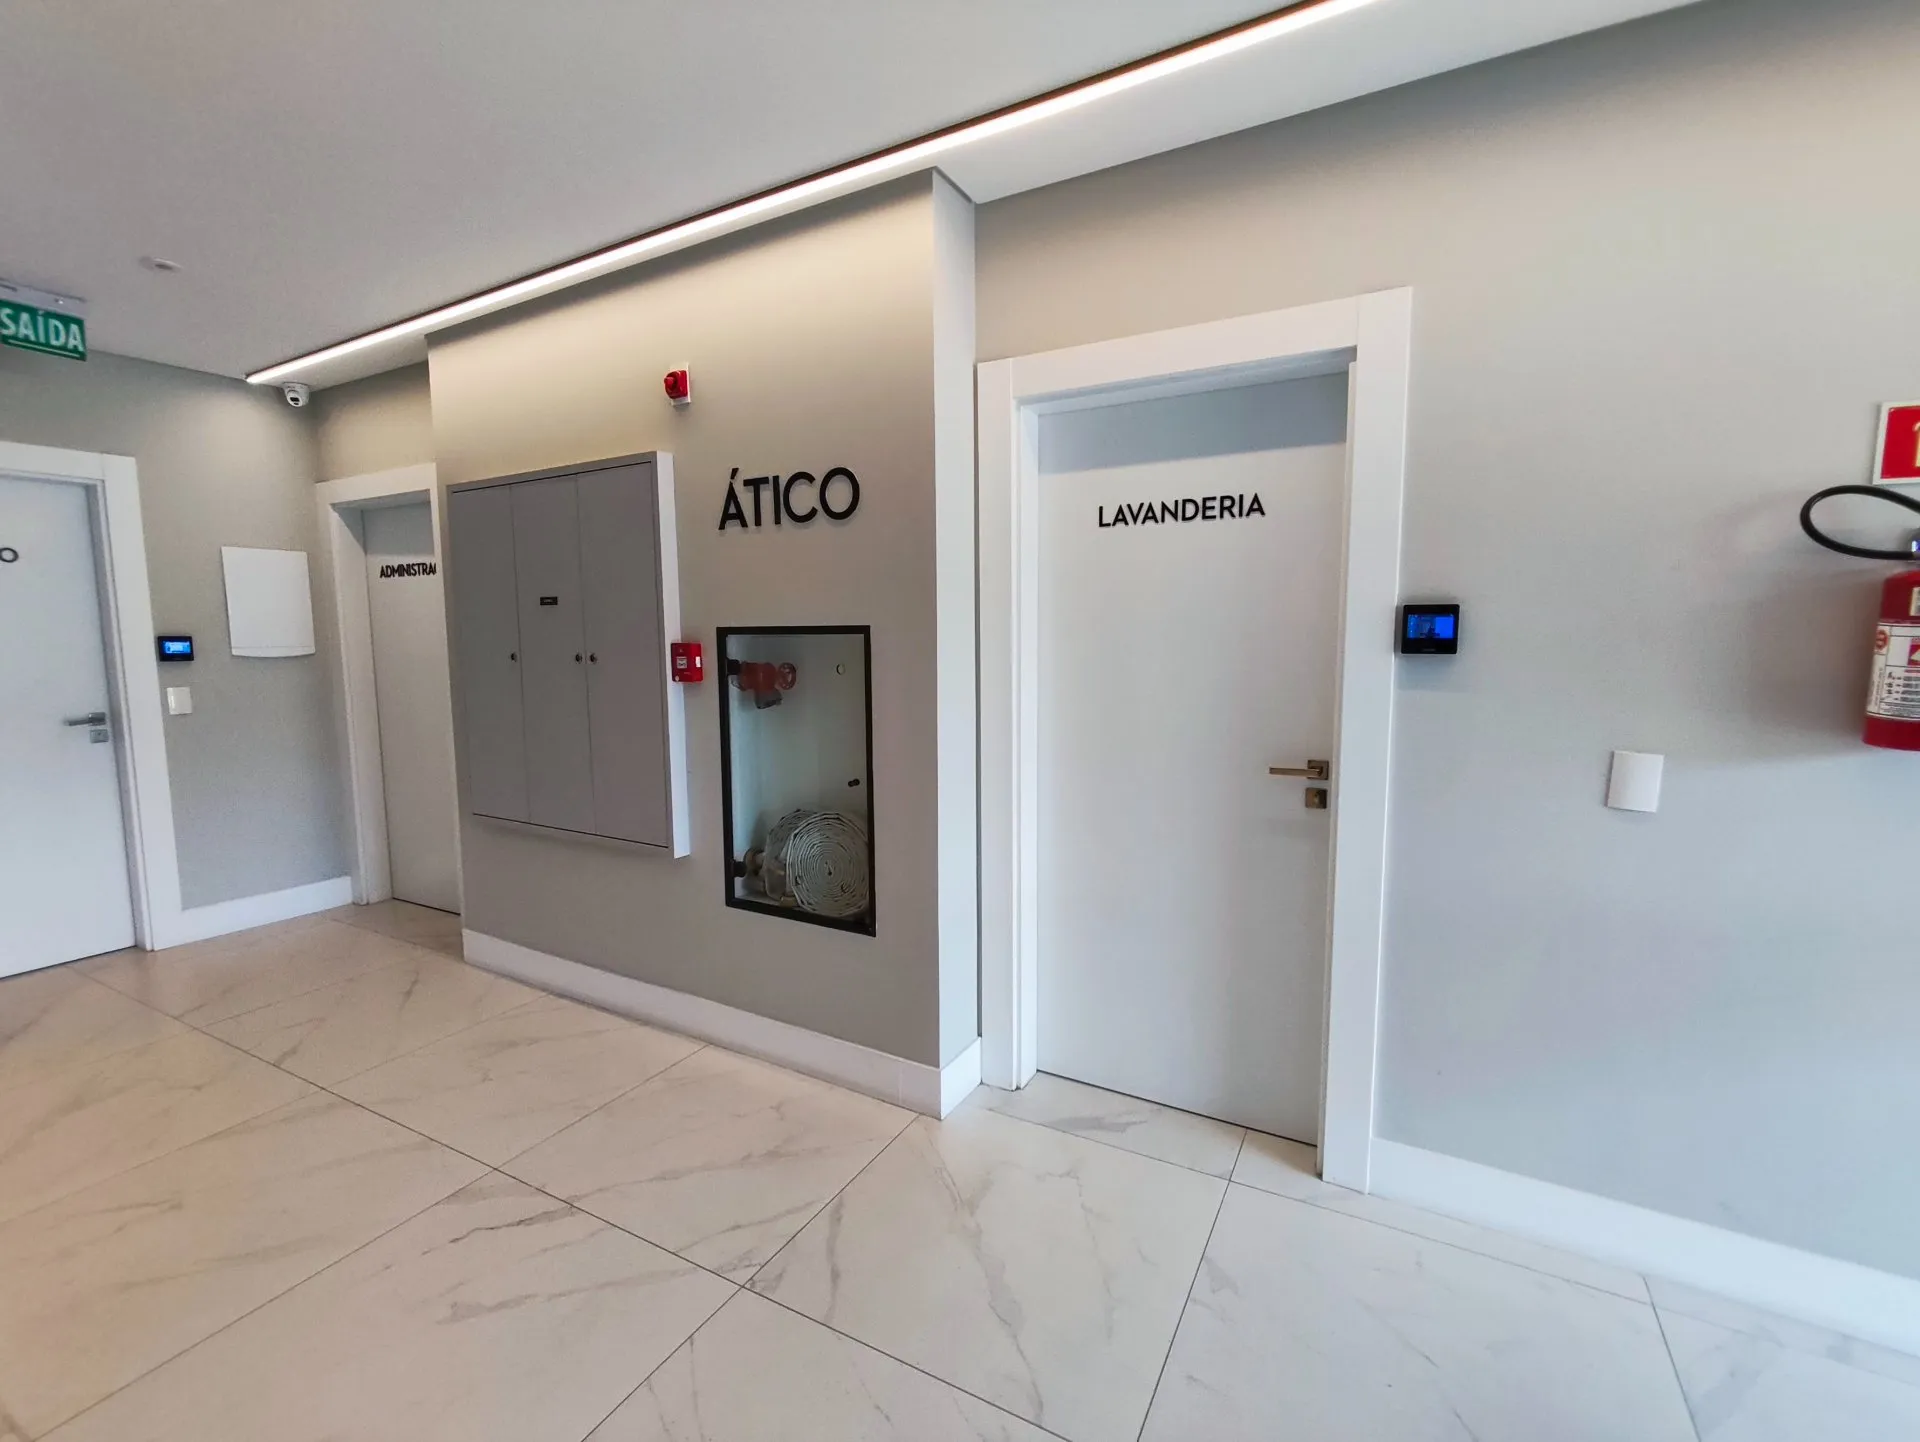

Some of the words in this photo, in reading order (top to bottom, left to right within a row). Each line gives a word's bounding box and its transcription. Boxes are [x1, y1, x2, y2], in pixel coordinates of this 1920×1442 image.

[0, 307, 84, 352] SAÍDA
[718, 466, 861, 531] ÁTICO
[1098, 493, 1266, 527] LAVANDERIA
